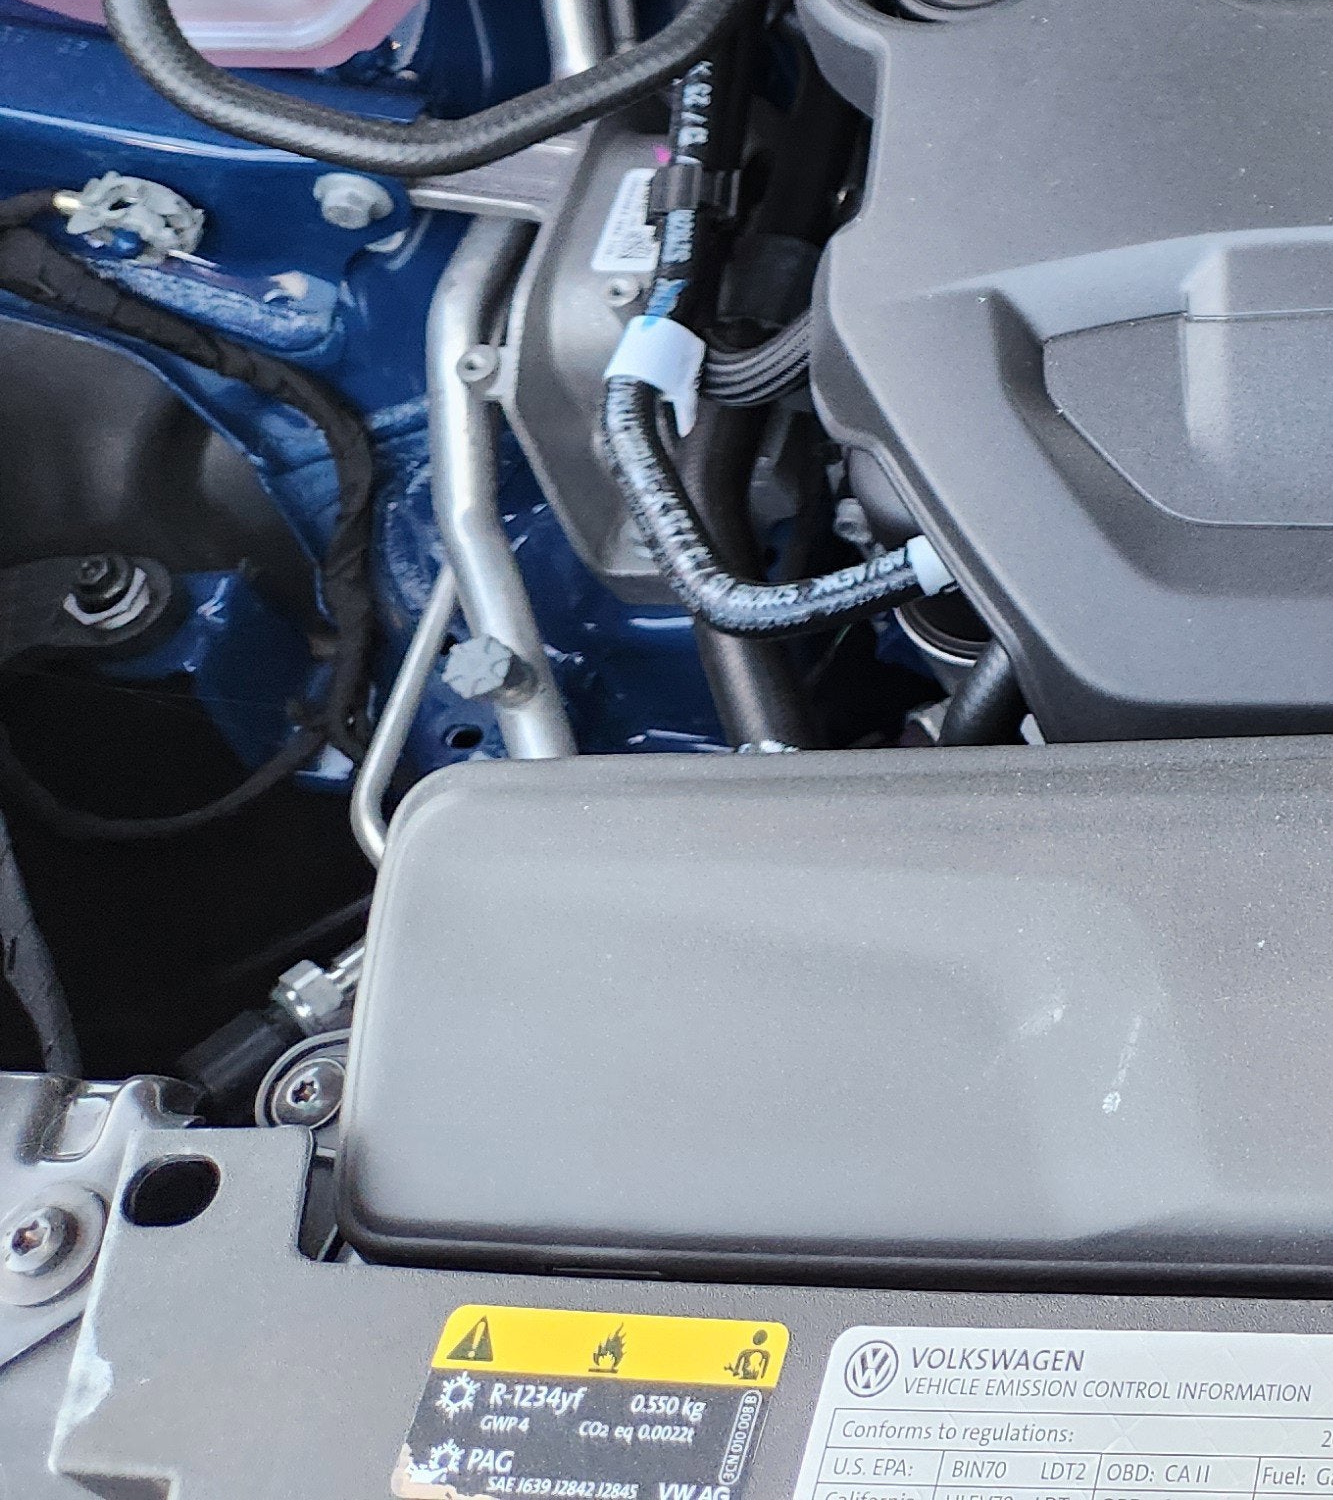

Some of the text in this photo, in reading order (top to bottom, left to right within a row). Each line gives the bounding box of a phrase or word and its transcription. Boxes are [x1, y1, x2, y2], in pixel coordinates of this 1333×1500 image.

[911, 1346, 1085, 1371] VOLKSWAGEN
[490, 1384, 586, 1415] R-1234yf
[903, 1377, 1312, 1402] VEHICLE EMISSION CONTROL INFORMATION
[630, 1394, 706, 1421] 0.550 kg
[480, 1415, 529, 1433] GWP 4
[578, 1421, 694, 1444] CO2 eq 0.0022t
[731, 1431, 747, 1454] 010
[744, 1395, 757, 1404] B
[842, 1420, 1074, 1446] Conforms to regulations:
[467, 1448, 514, 1473] PAG
[833, 1457, 914, 1477] U.S. EPA:
[951, 1461, 1087, 1481] BIN70 LDT2
[1106, 1464, 1155, 1483] OBD:
[1165, 1465, 1190, 1483] CA
[1262, 1465, 1306, 1486] Fuel:
[486, 1476, 639, 1499] SAE J639 J2842 J2845
[658, 1482, 731, 1500] VW AG
